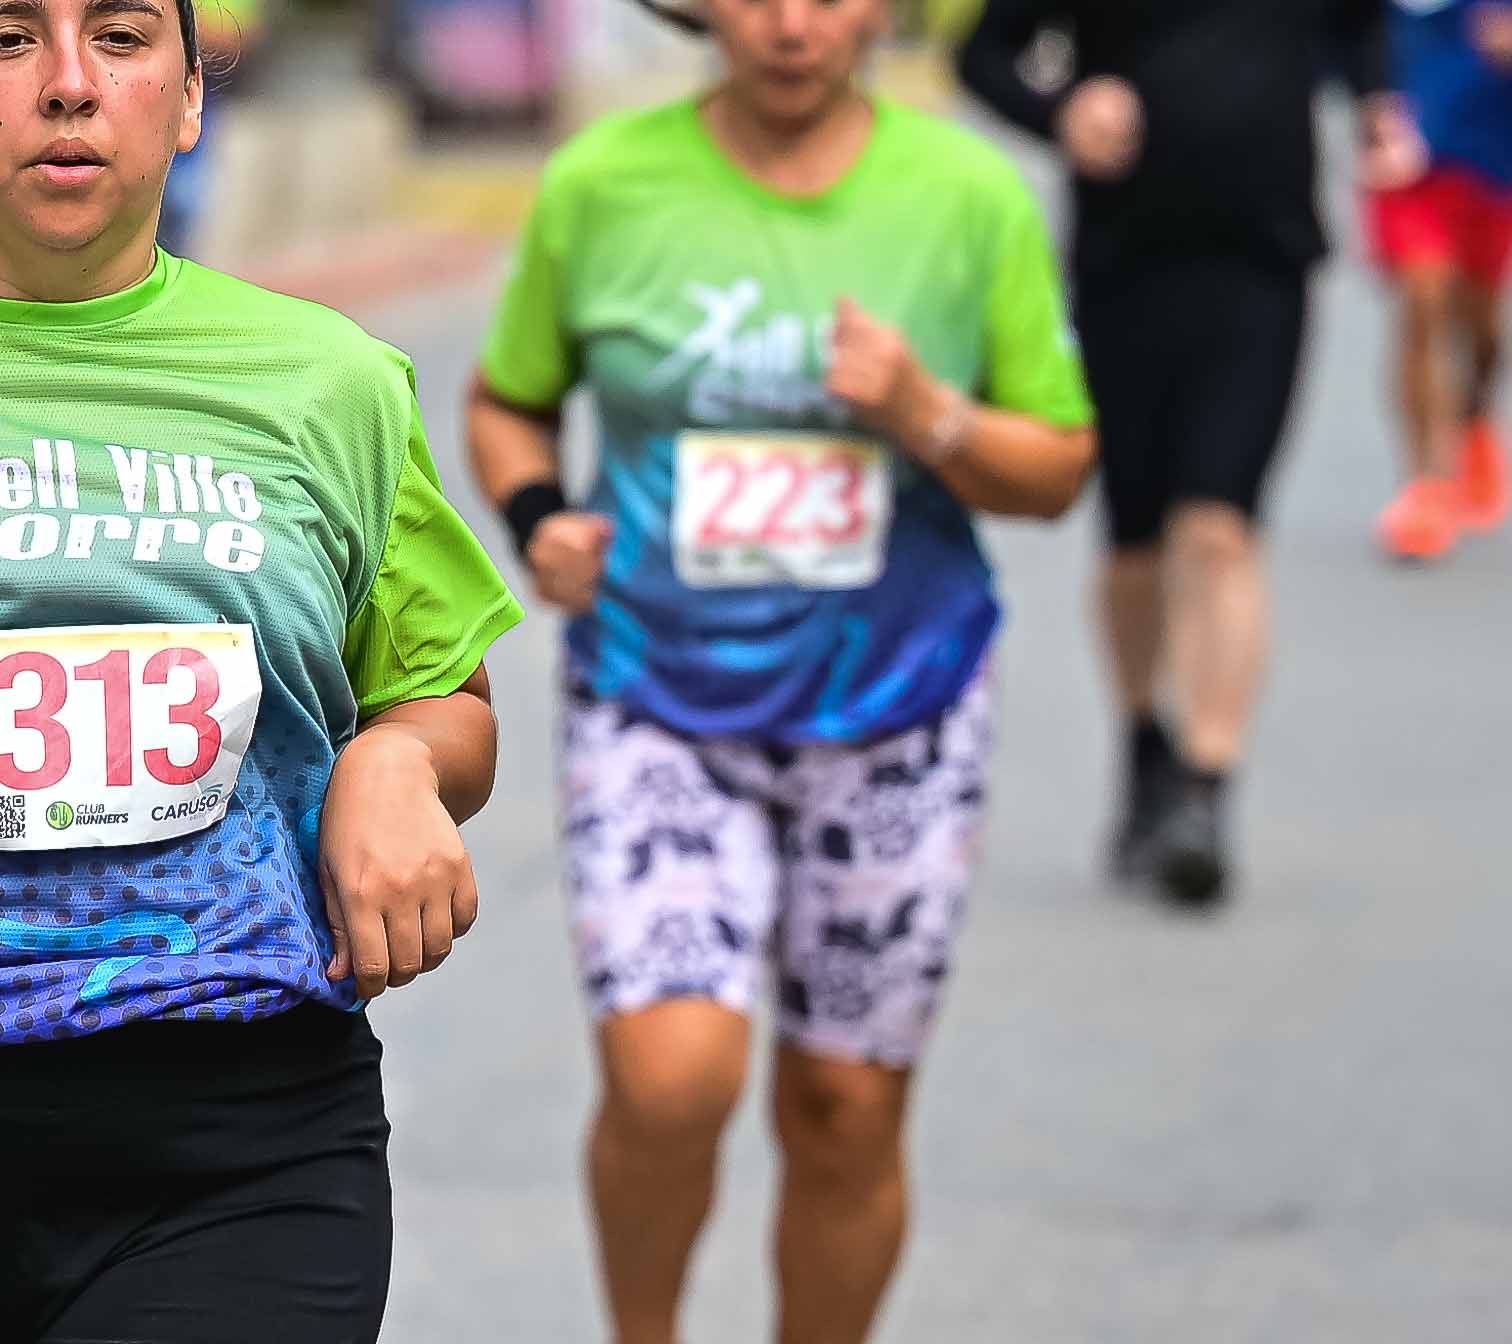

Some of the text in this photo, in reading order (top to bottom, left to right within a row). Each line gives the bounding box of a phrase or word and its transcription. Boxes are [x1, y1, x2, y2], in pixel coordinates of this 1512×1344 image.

[696, 452, 867, 547] 223
[76, 803, 105, 814] CLUB
[151, 793, 219, 822] CARUSO
